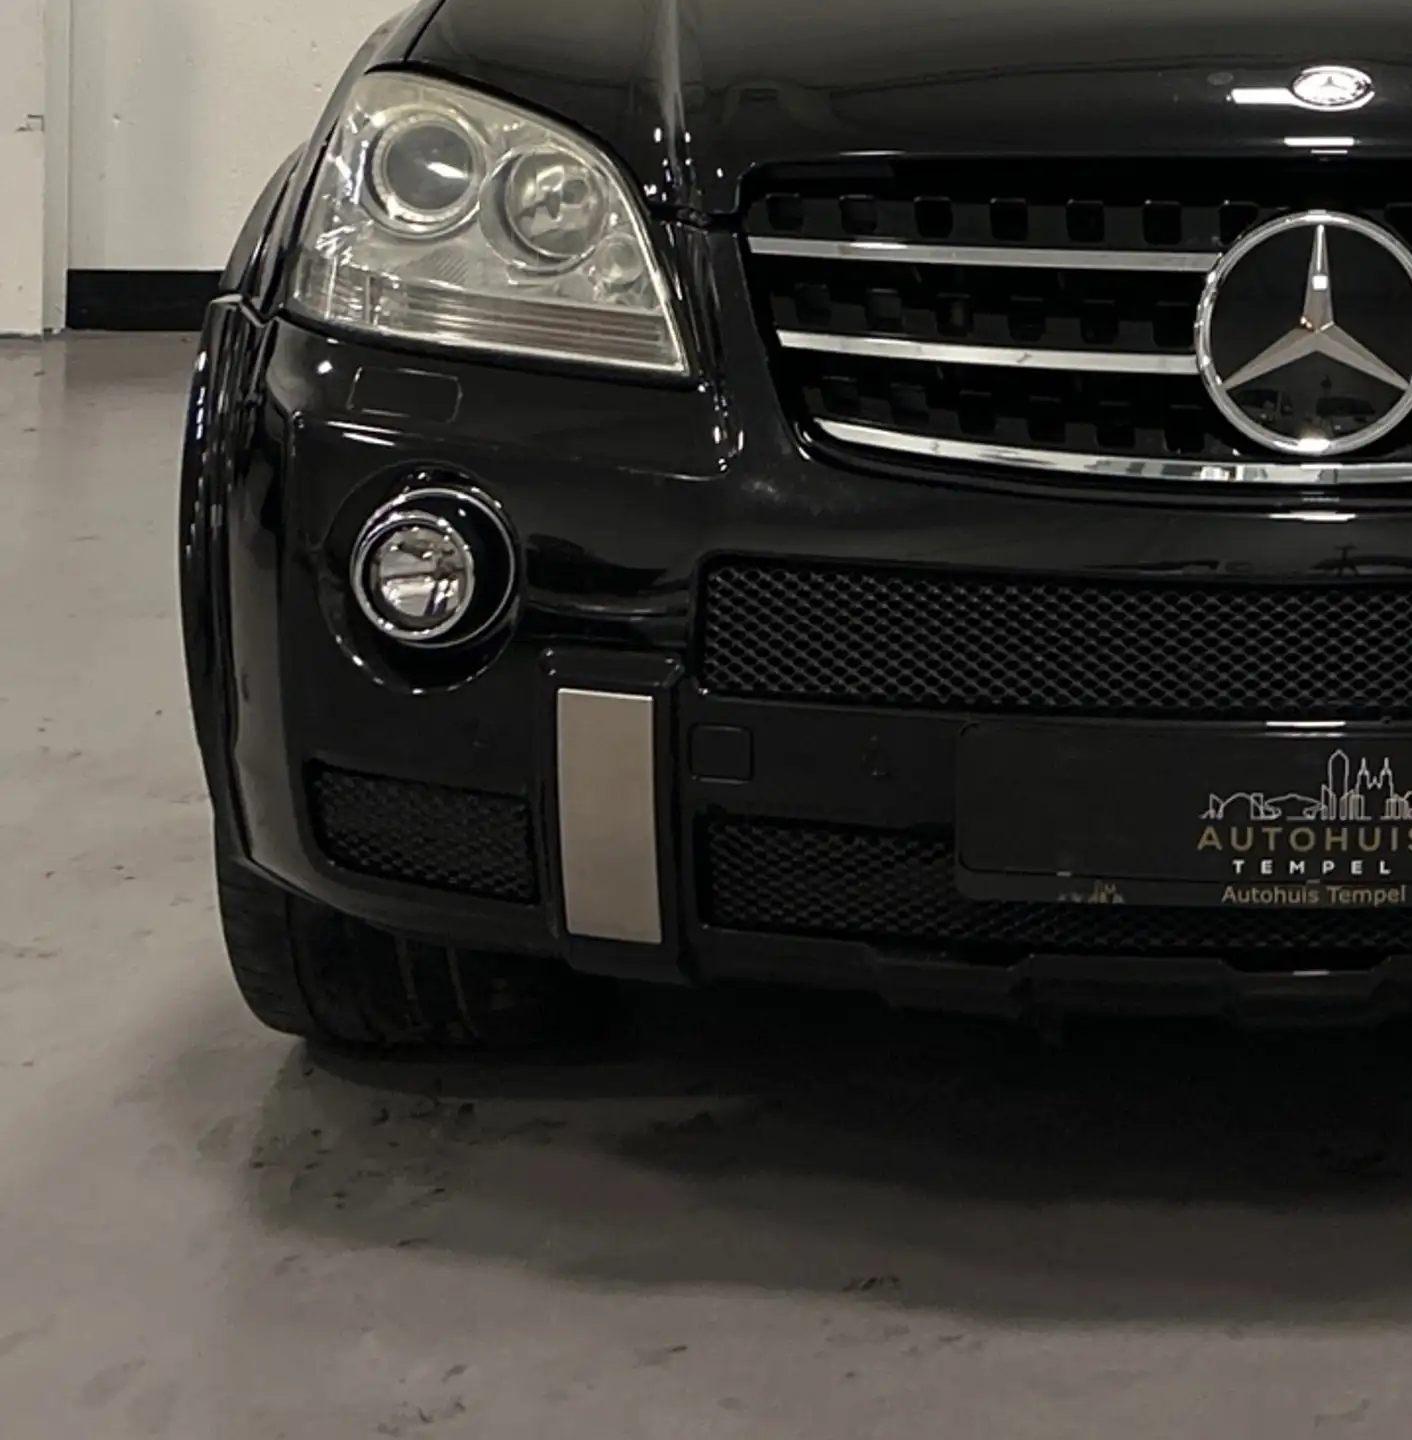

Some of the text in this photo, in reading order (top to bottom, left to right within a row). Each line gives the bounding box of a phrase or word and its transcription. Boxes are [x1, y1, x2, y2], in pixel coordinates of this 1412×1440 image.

[1232, 859, 1392, 875] TEMPEL
[1220, 884, 1407, 907] Autohuis Tempel
